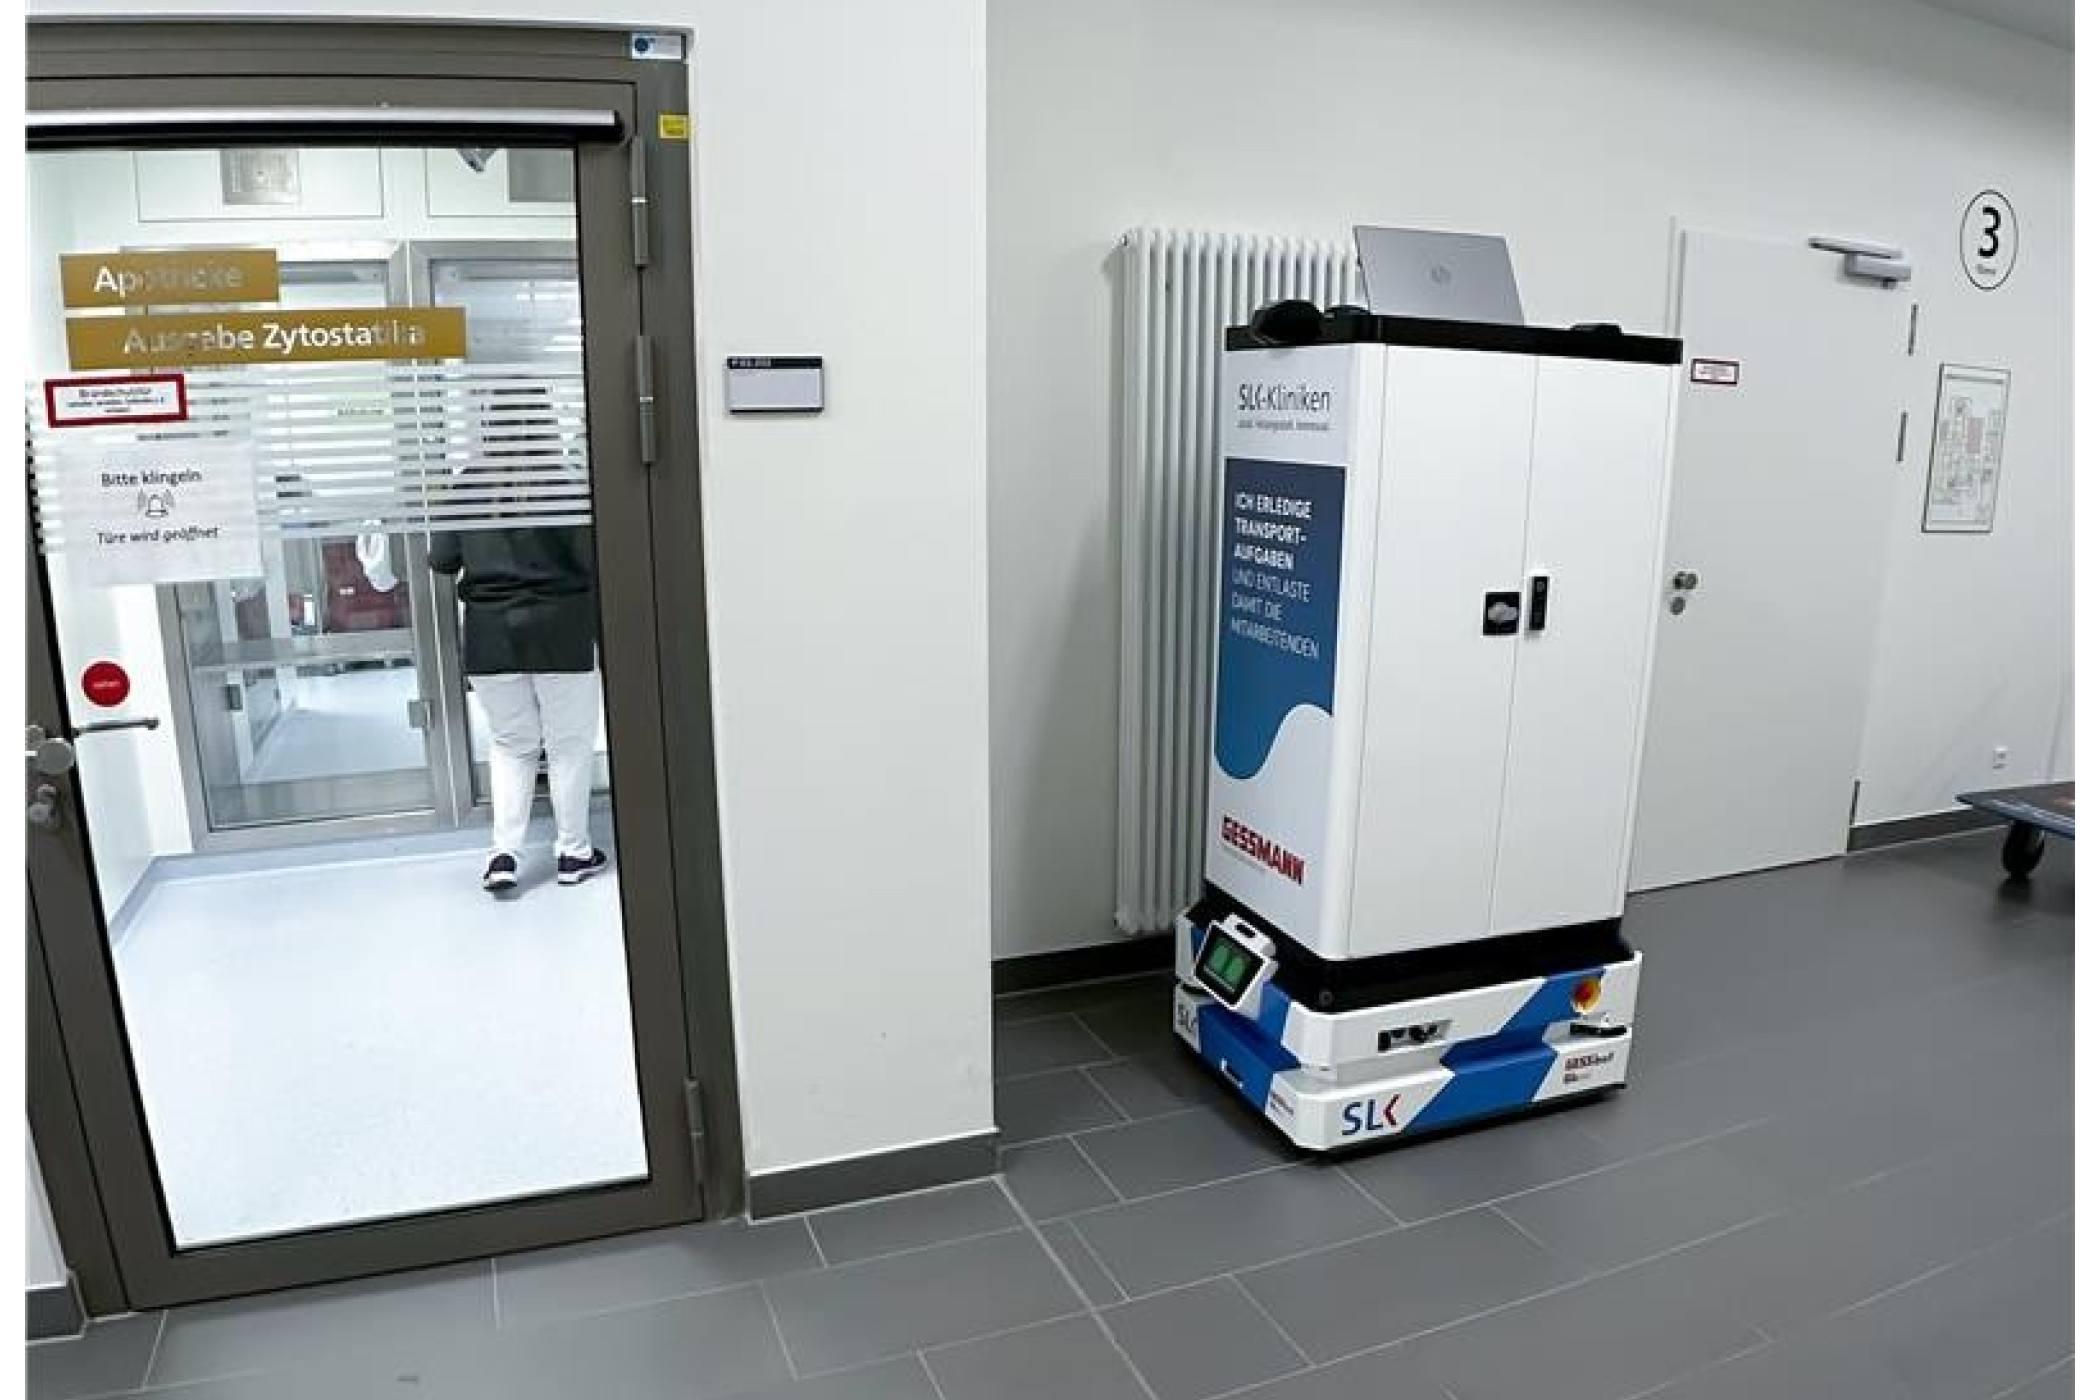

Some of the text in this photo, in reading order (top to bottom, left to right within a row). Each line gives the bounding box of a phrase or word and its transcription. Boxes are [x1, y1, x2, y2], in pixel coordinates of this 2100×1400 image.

[1977, 206, 2001, 258] 3
[101, 468, 202, 487] Bitte klingeln
[1234, 492, 1312, 520] ICH ERLEDIGE
[98, 525, 218, 545] Türe wird geöffnet
[1234, 516, 1307, 545] TRANSPORT-
[1234, 542, 1294, 570] AUFGABEN
[1232, 567, 1311, 603] UND ENTLASTE
[1232, 591, 1284, 621] DAMIT DIE
[1232, 616, 1320, 660] MITARBEITENDEN
[1222, 814, 1305, 886] GESSMANN
[1341, 1094, 1402, 1137] SLK
